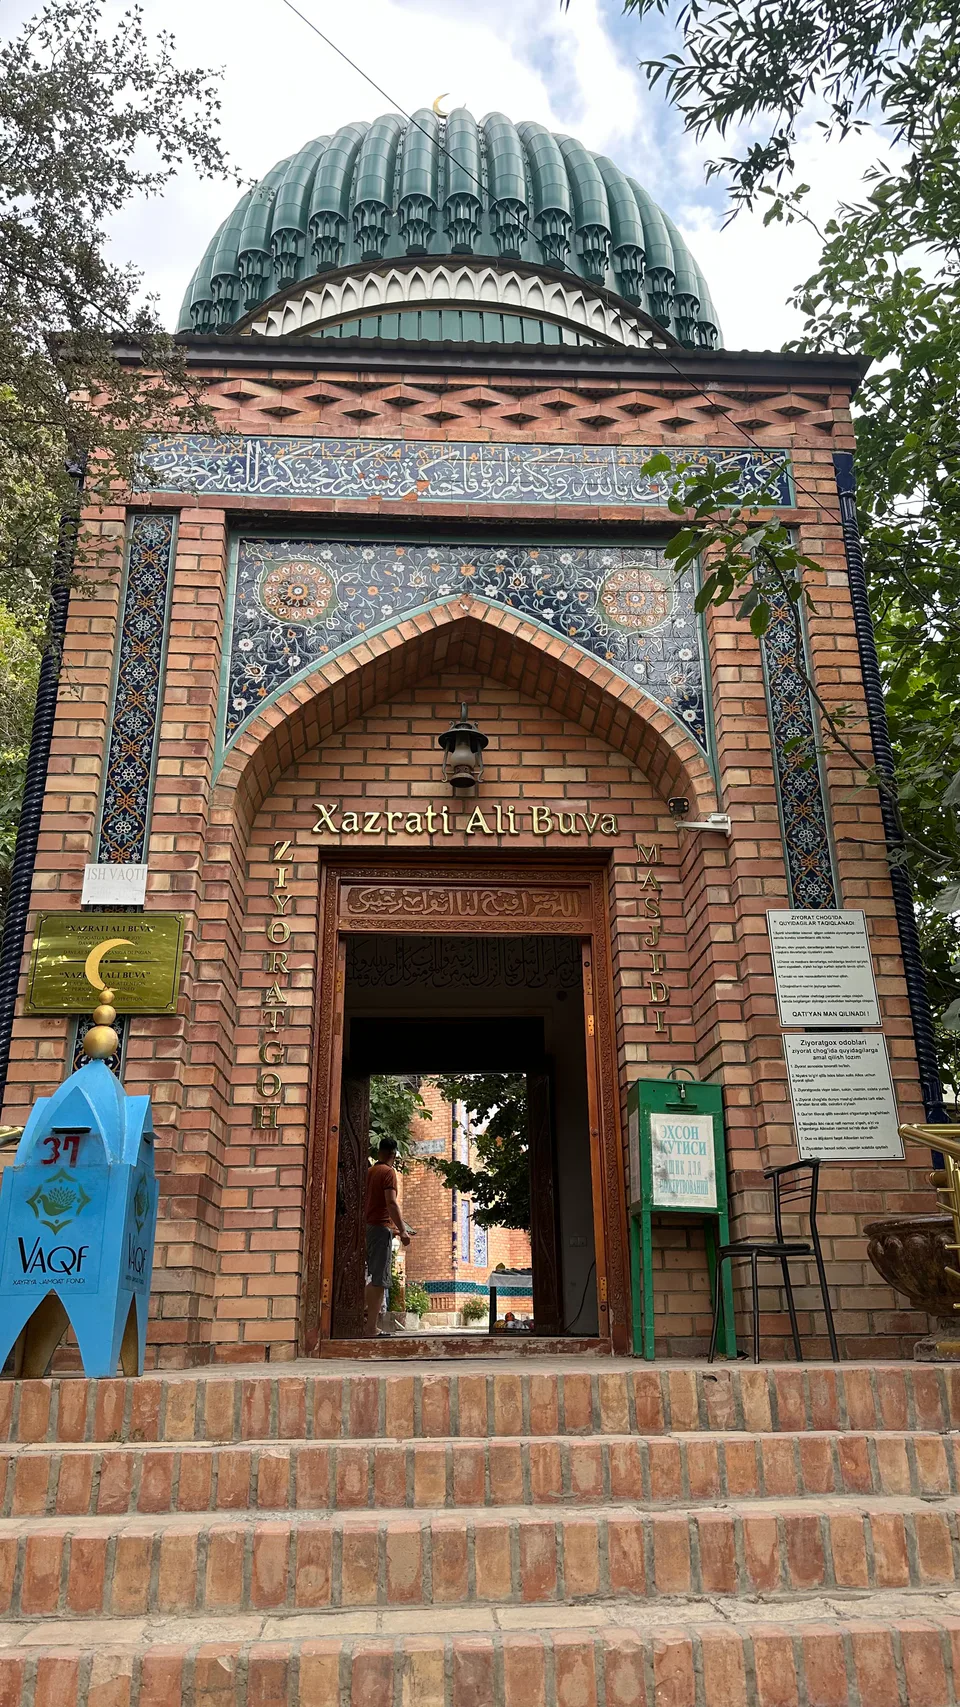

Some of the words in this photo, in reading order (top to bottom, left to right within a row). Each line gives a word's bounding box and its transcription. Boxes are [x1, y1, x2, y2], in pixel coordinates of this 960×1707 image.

[311, 803, 454, 836] Xazrati
[464, 804, 520, 836] Ali
[529, 804, 620, 837] Buva
[87, 868, 106, 881] ISH
[109, 868, 146, 884] VAQTI
[634, 843, 670, 1034] MASJIDI
[253, 840, 295, 1130] ZIYORATGOH
[800, 1039, 838, 1048] Ziyoratgox
[827, 1054, 845, 1062] qilish
[838, 1047, 879, 1055] quyidagilarga
[41, 1136, 81, 1168] 37
[17, 1236, 90, 1276] VAQF
